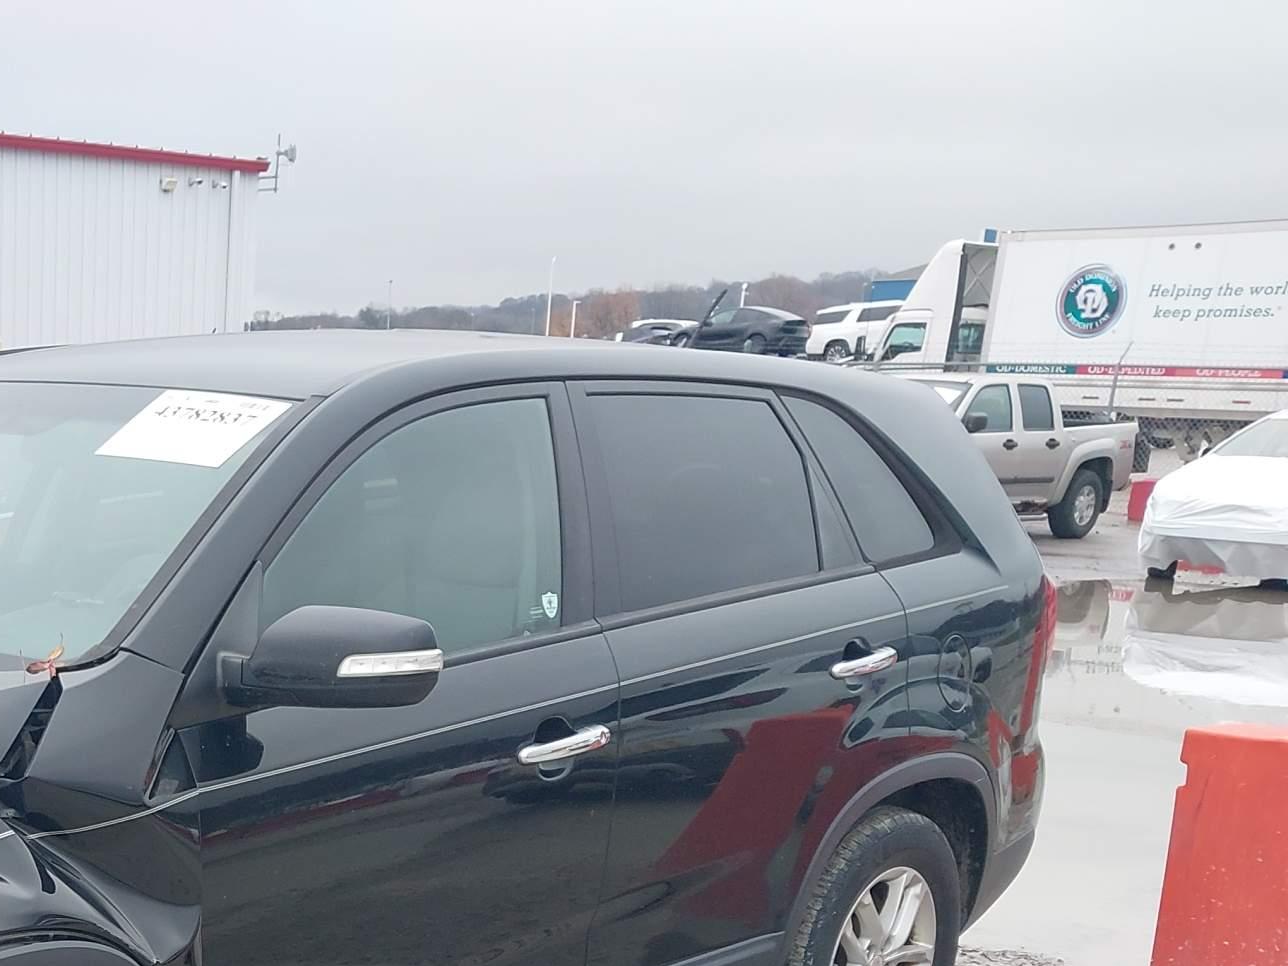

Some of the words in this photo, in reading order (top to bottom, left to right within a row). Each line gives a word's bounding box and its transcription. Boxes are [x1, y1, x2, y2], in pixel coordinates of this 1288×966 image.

[1148, 283, 1213, 301] Helping
[1217, 282, 1244, 297] the
[1152, 304, 1192, 322] keep
[1194, 304, 1275, 322] promises.
